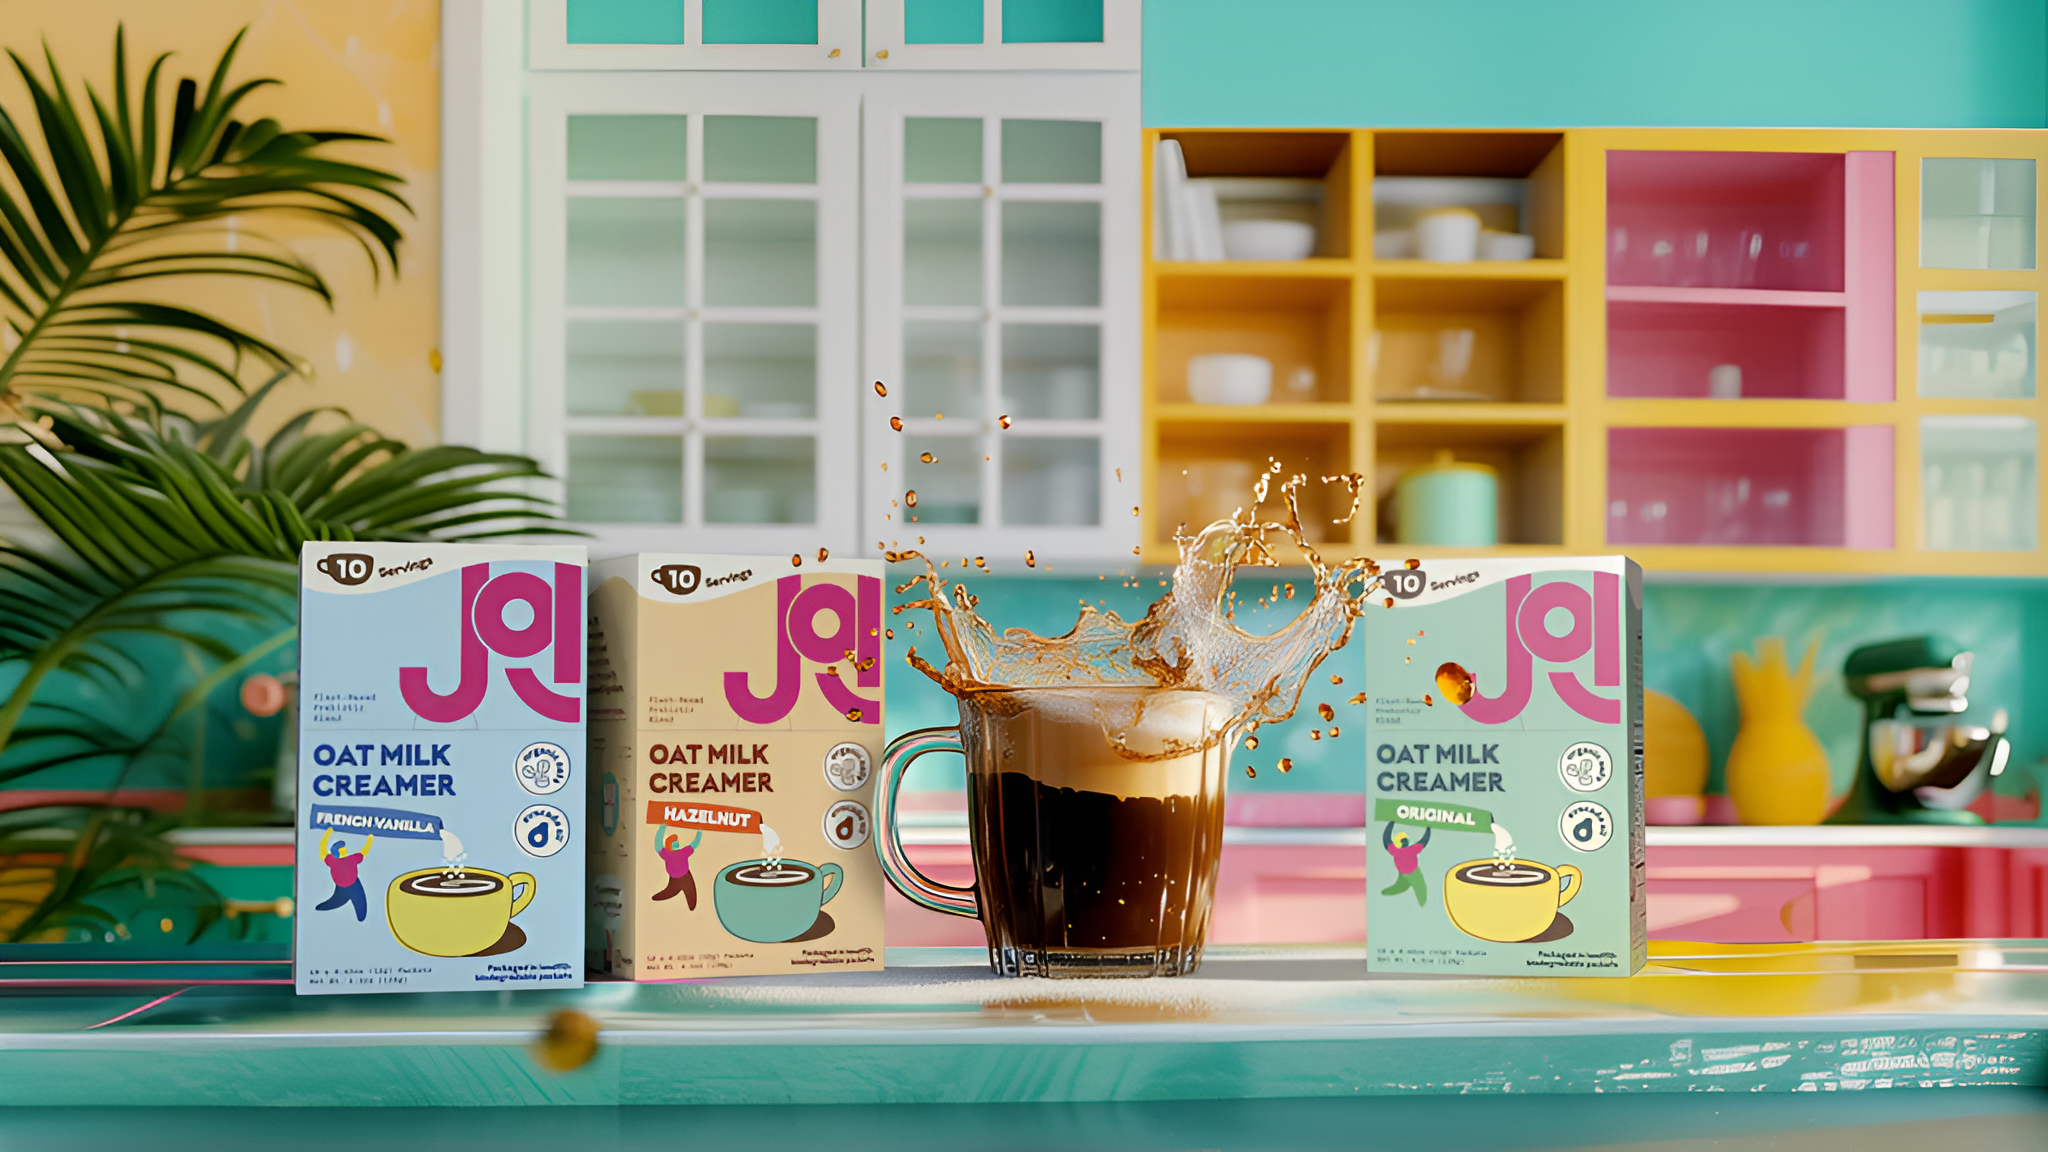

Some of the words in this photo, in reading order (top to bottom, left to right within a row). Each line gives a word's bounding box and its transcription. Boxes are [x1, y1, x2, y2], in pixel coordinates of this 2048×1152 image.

[336, 559, 367, 579] 10
[378, 557, 434, 578] Servings
[668, 569, 695, 589] 10
[705, 568, 753, 588] Servings
[1393, 574, 1420, 593] 10
[1430, 570, 1480, 591] Servings
[313, 744, 375, 767] OAT
[380, 744, 452, 767] MILK
[649, 744, 702, 765] OAT
[708, 744, 769, 765] MILK
[1377, 744, 1430, 765] OAT
[1436, 744, 1499, 765] MILK
[313, 774, 457, 797] CREAMER
[648, 772, 774, 793] CREAMER
[1377, 771, 1506, 793] CREAMER
[316, 812, 374, 829] FRENCH
[374, 815, 436, 834] VANILLA
[663, 806, 752, 828] HAZELNUT
[1396, 805, 1476, 826] ORIGINAL
